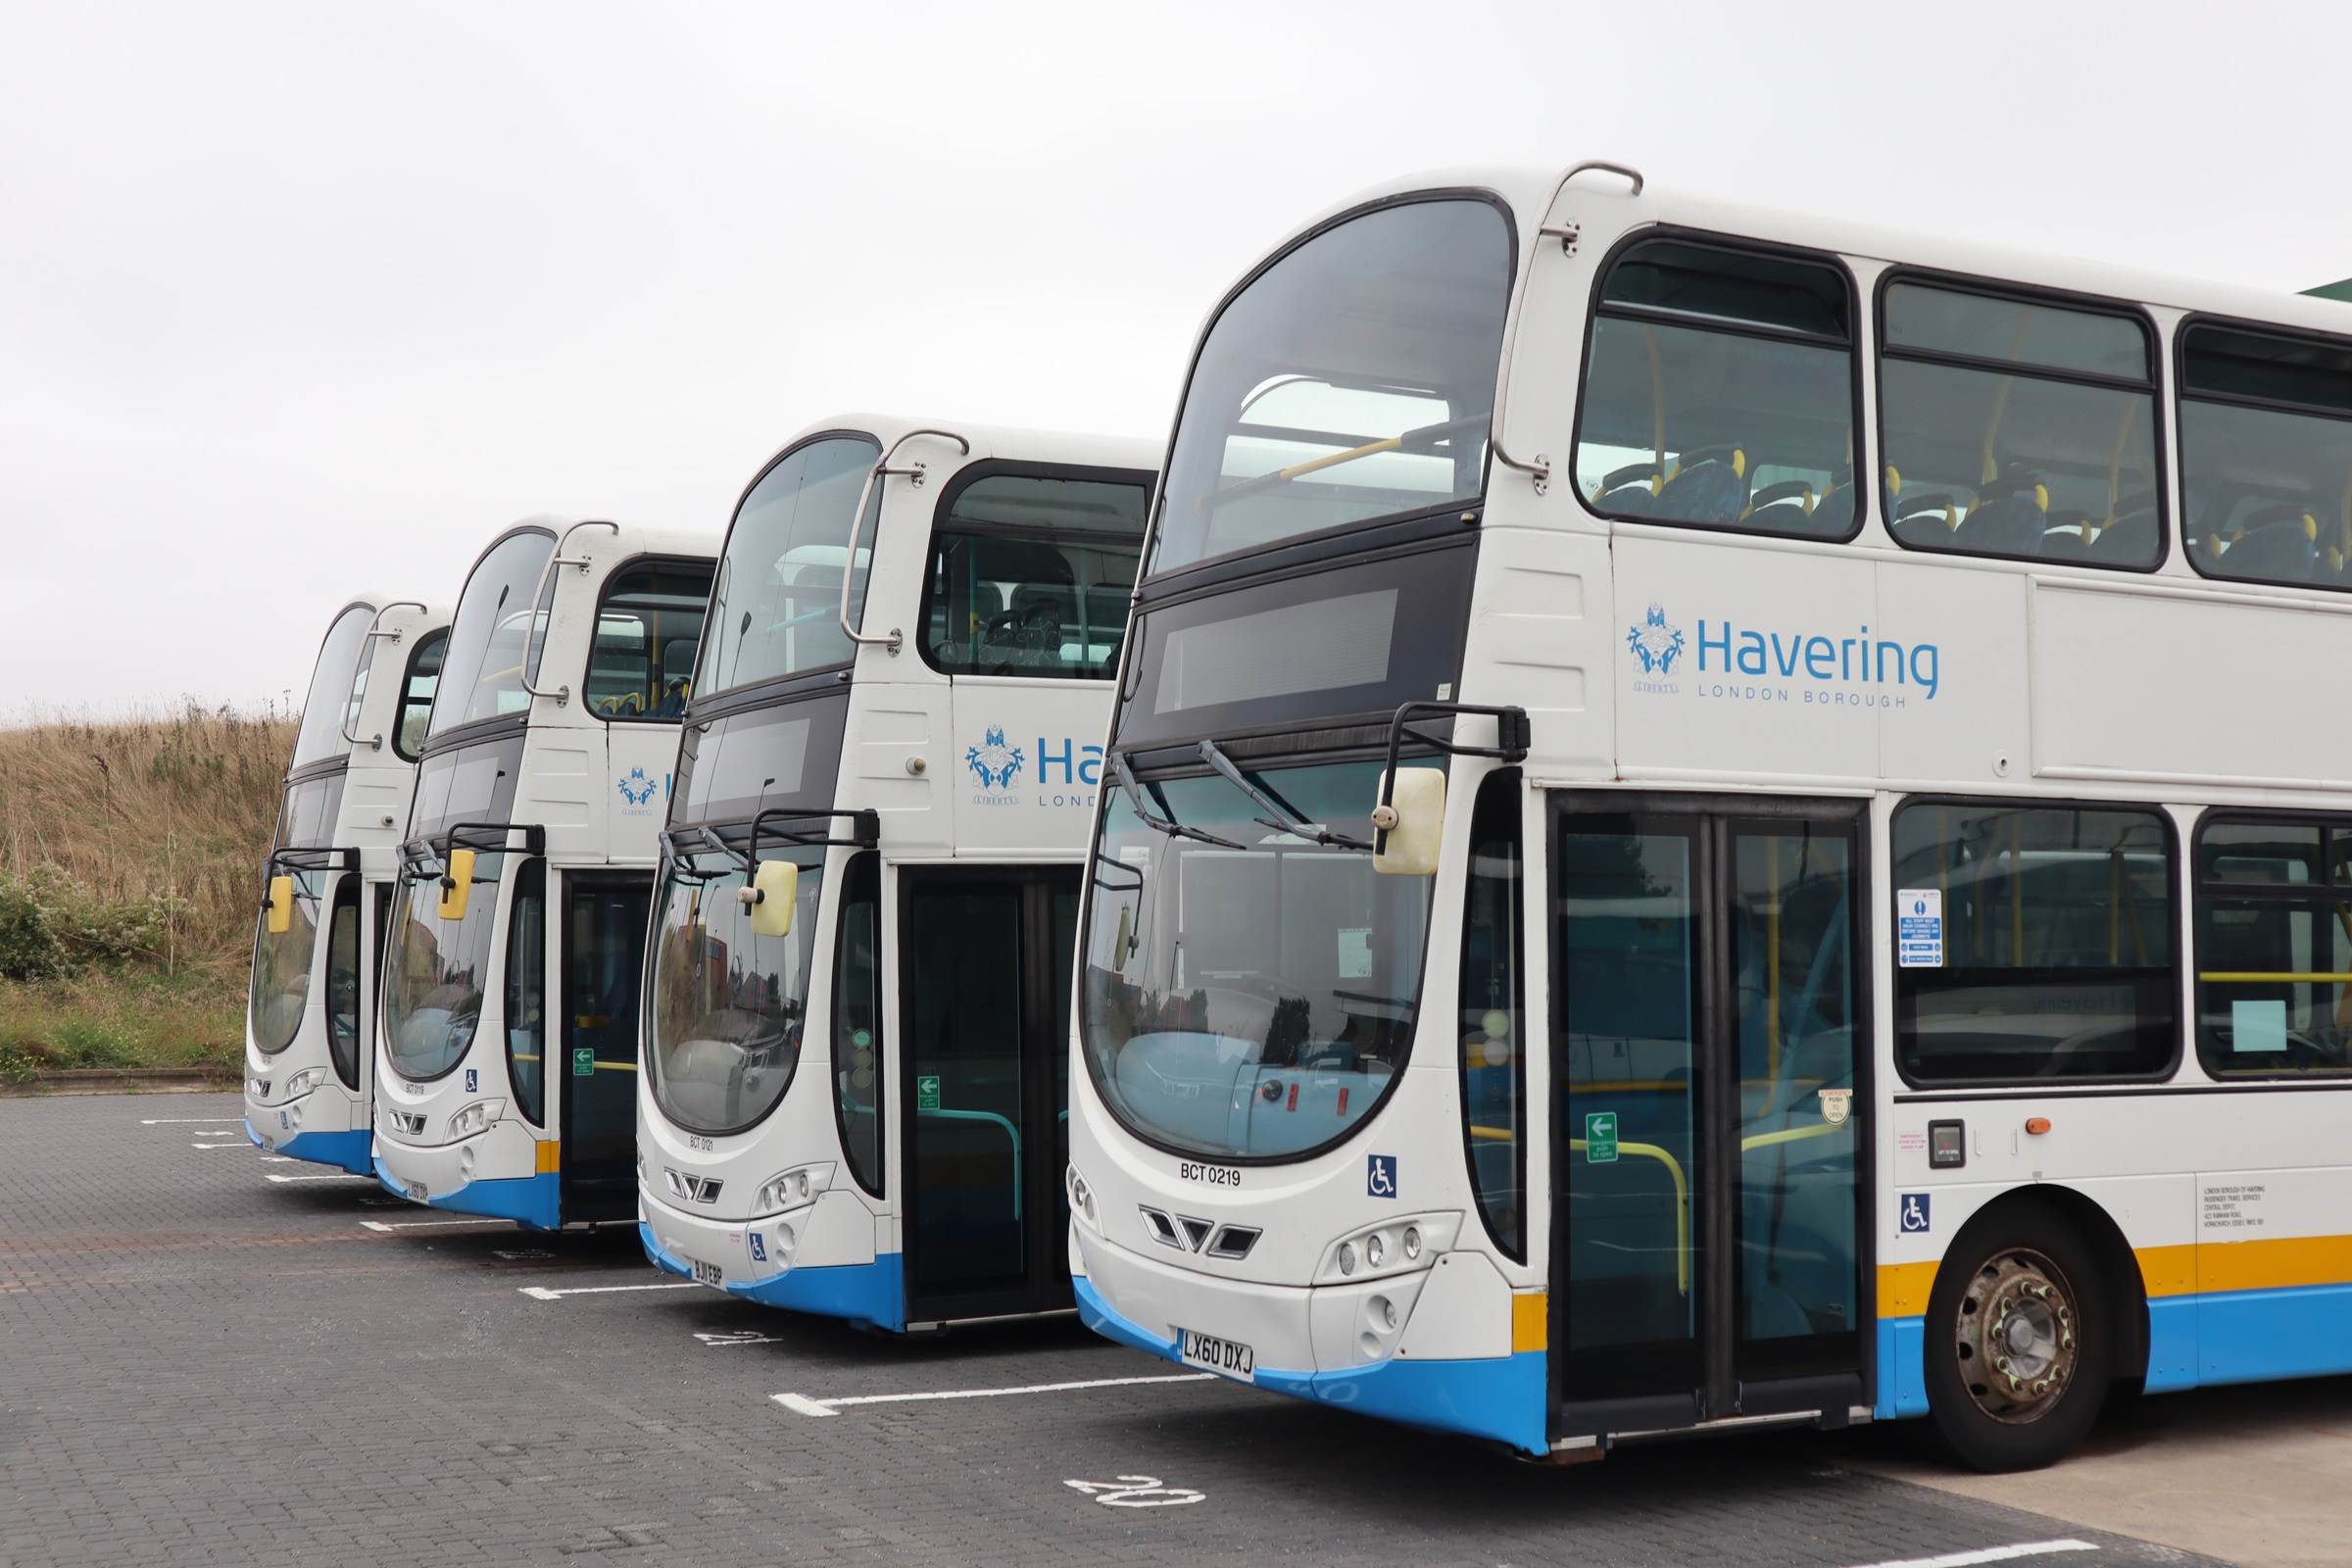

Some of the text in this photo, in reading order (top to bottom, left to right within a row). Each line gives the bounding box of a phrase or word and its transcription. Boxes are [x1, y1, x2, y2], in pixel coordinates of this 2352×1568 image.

[1697, 619, 1938, 700] Havering
[1637, 681, 1677, 693] LIBERTY
[1698, 684, 1905, 709] LONDON BOROUGH
[975, 796, 1014, 806] LIBERTY
[690, 1136, 713, 1152] BCT 0121
[1181, 1163, 1241, 1186] BCT 0219
[709, 1265, 722, 1286] EBP
[1184, 1332, 1253, 1374] LX60 DXJ
[1063, 1475, 1205, 1507] 20
